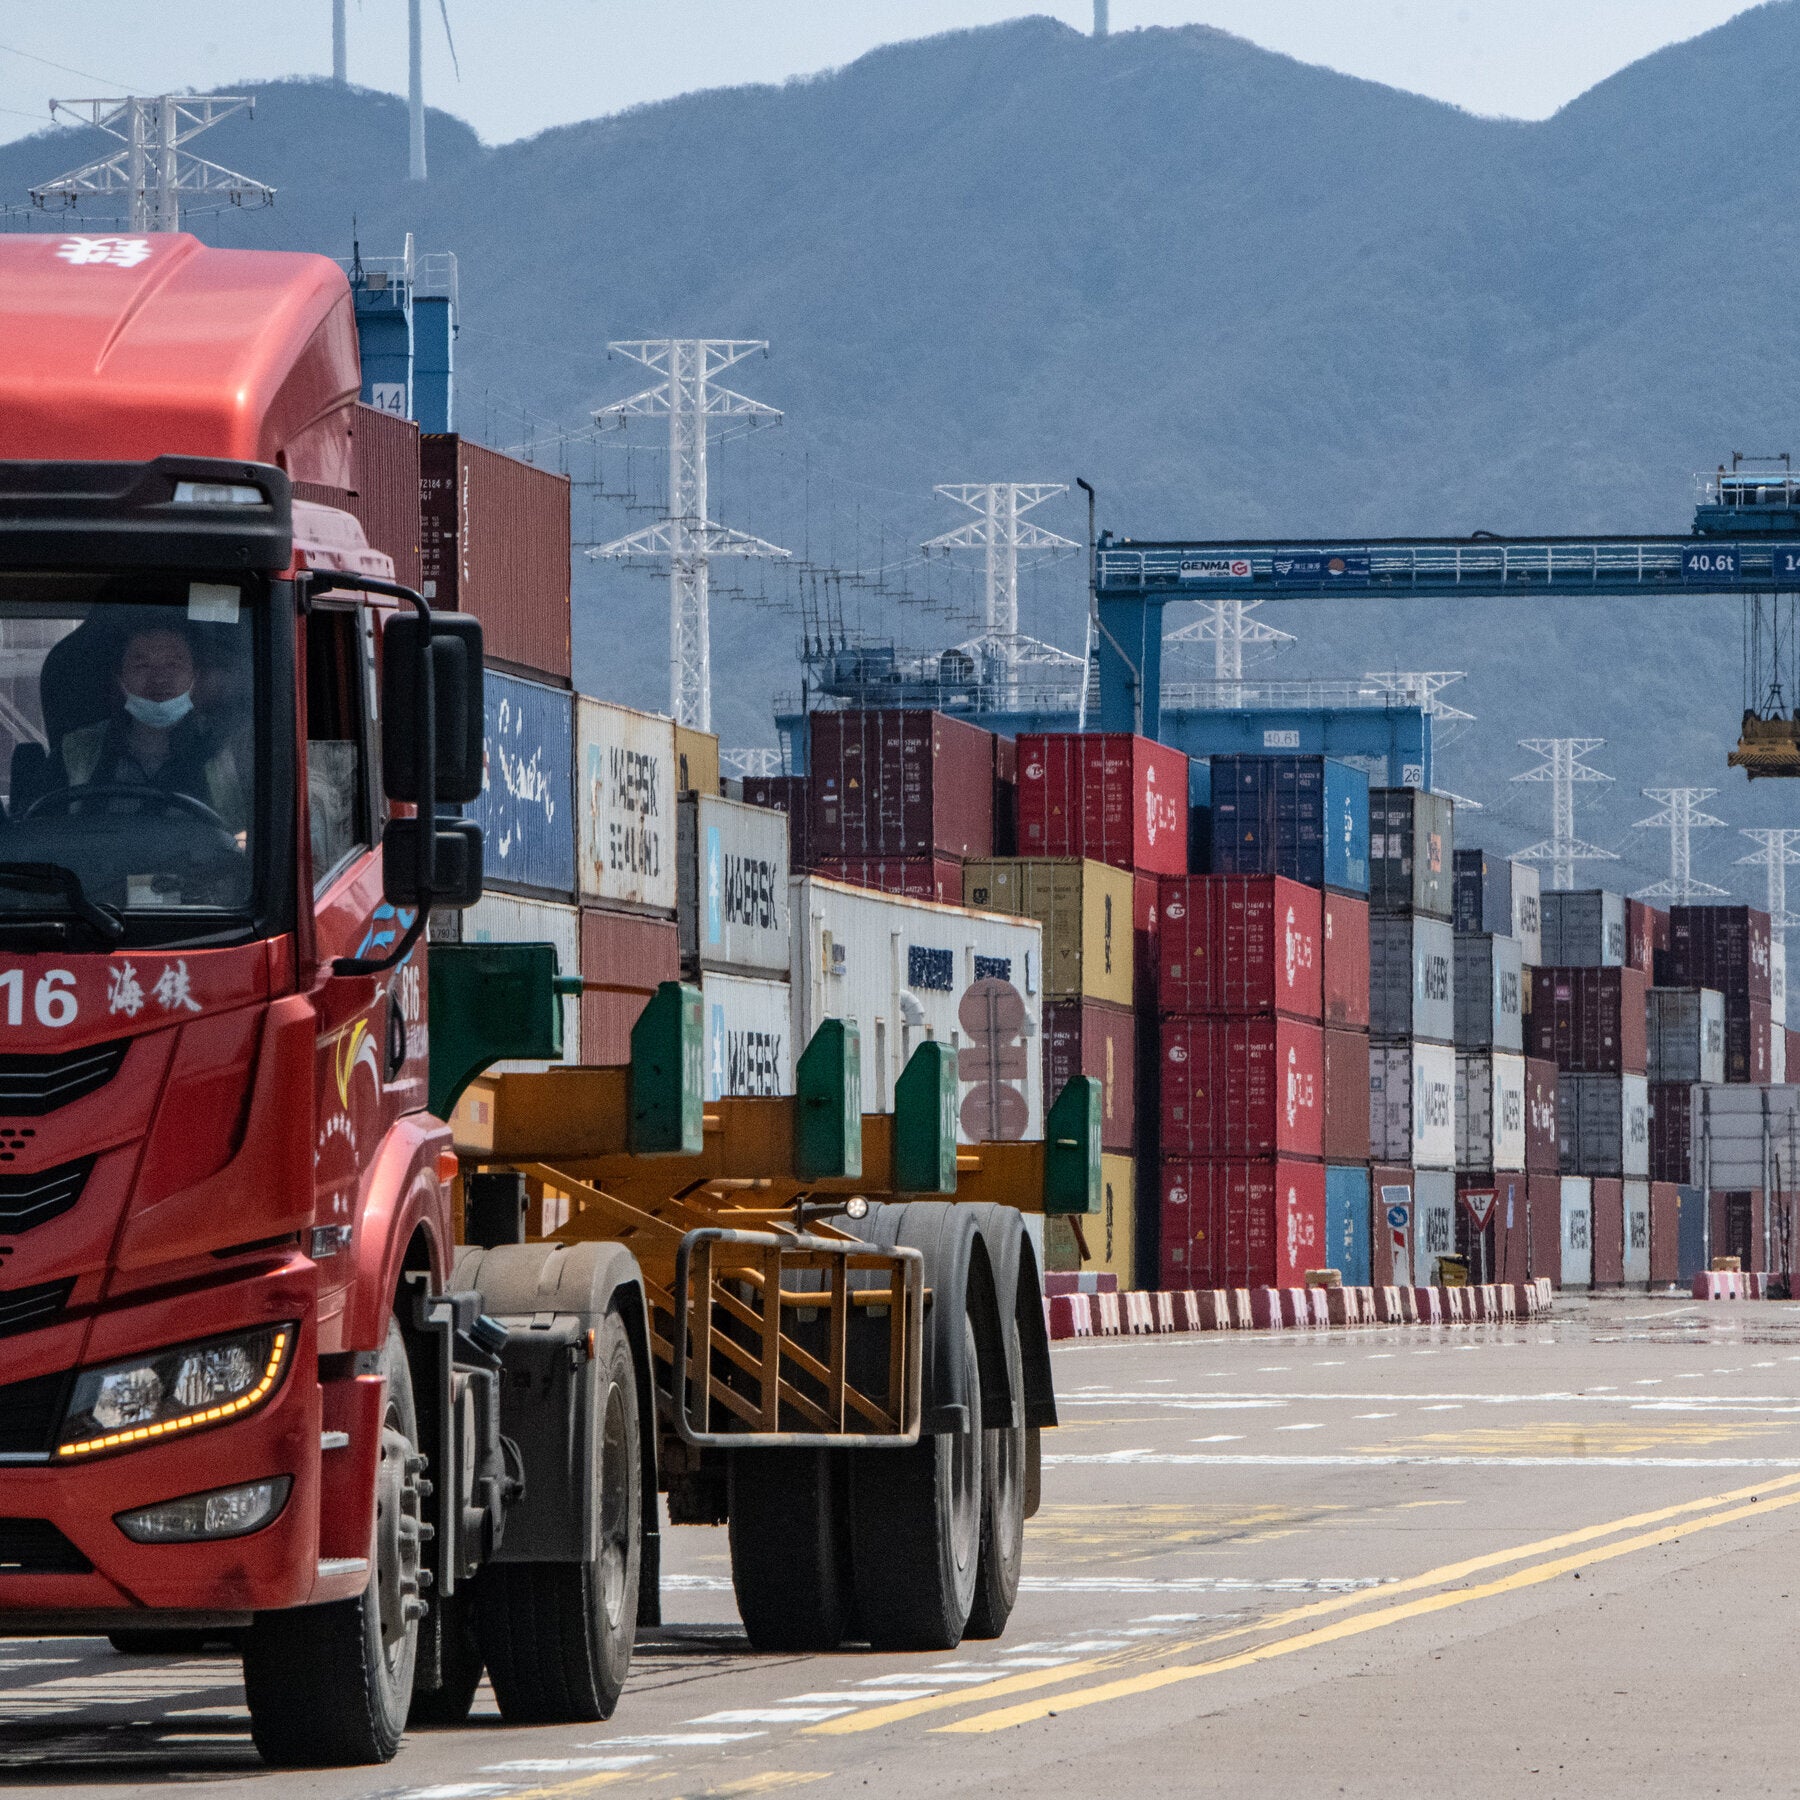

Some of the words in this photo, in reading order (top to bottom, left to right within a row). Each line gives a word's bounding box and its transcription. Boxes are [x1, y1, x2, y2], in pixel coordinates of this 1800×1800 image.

[375, 390, 402, 413] 14
[1181, 561, 1230, 571] GENMA
[1688, 555, 1734, 571] 40.6t
[1404, 768, 1421, 783] 26
[725, 853, 778, 930] MAERSK
[402, 965, 420, 1022] 816
[727, 1029, 781, 1096] MAERSK
[1473, 1197, 1485, 1211] 让
